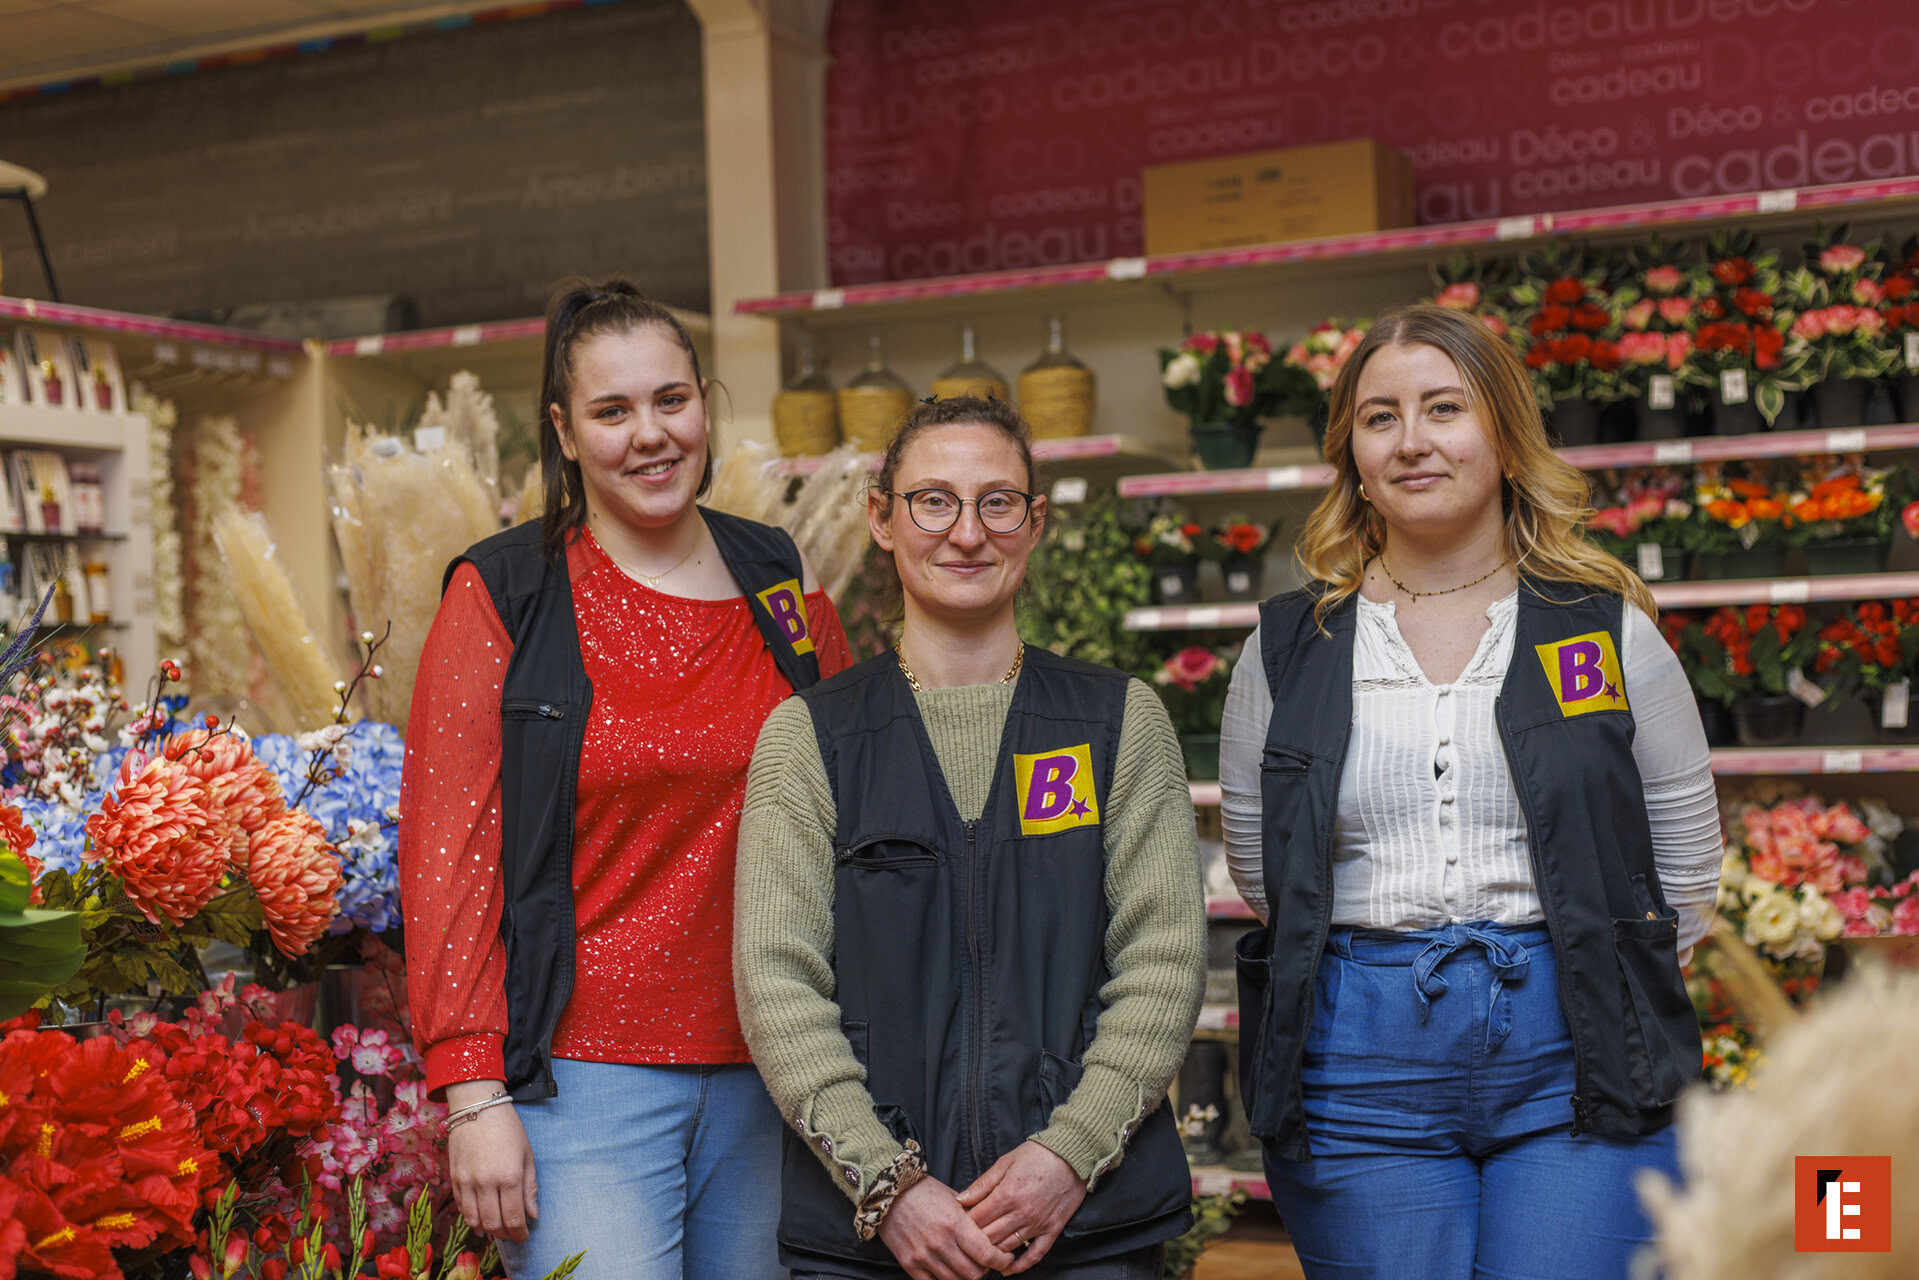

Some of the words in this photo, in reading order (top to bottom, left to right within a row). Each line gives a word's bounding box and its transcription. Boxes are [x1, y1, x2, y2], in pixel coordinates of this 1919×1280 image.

[1438, 0, 1656, 60] cadeau
[1051, 51, 1243, 113] cadeau
[1548, 62, 1700, 107] cadeau
[1509, 123, 1619, 167] Déco
[1667, 102, 1763, 140] Déco
[1509, 157, 1661, 199] cadeau
[1672, 130, 1919, 198] cadea
[892, 221, 1107, 278] cadeau
[766, 588, 808, 646] B
[1558, 640, 1606, 704] B
[1024, 754, 1080, 822] B
